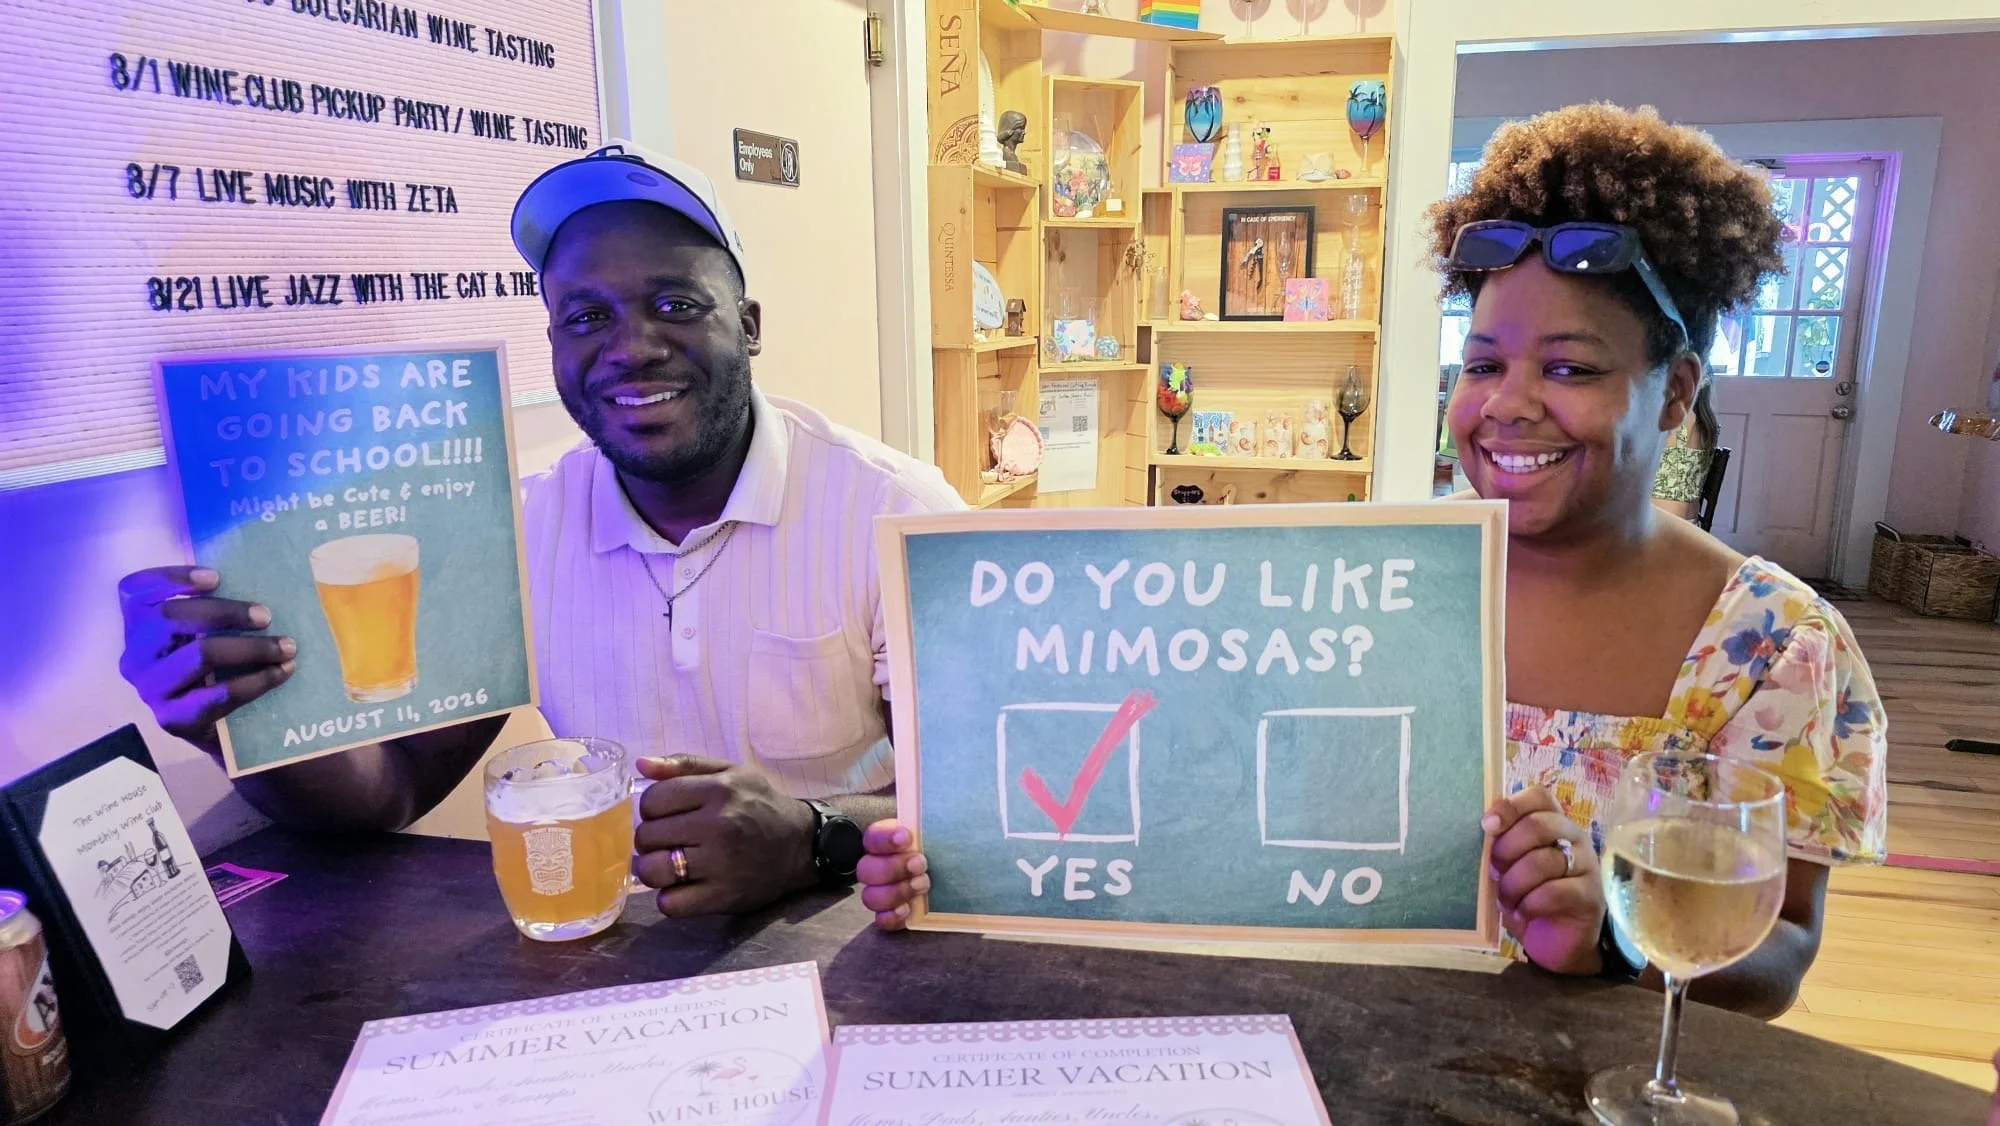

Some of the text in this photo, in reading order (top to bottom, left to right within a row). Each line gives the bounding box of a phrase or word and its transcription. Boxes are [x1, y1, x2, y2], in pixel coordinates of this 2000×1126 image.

[427, 12, 478, 53] WINE
[485, 27, 555, 68] TASTING
[110, 52, 161, 94] 8/1
[168, 58, 242, 105] WINE
[245, 74, 304, 113] CLUB
[311, 83, 386, 123] PICKUP
[470, 108, 517, 142] WINE
[522, 117, 588, 150] TASTING
[738, 140, 773, 159] Employees
[739, 157, 755, 175] Only
[126, 162, 458, 213] 8/7 LIVE MUSIC WITH ZETA
[212, 275, 274, 309] LIVE
[284, 273, 344, 306] JAZZ
[351, 272, 404, 305] WITH
[411, 271, 451, 300] THE
[457, 271, 488, 299] CAT
[495, 271, 508, 297] &
[510, 270, 540, 297] THE
[200, 359, 473, 400] MY KIDS ARE
[216, 400, 469, 441] GOING BACK
[209, 437, 483, 487] TO SCHOOL!!!!
[230, 491, 301, 522] Might
[307, 491, 335, 509] be
[421, 477, 475, 500] enjoy
[315, 505, 406, 531] a BEER!
[970, 557, 1415, 612] DO YOU LIKE
[1016, 625, 1375, 677] MIMOSAS?
[283, 708, 385, 747] AUGUST
[428, 688, 489, 715] 2026
[1016, 854, 1133, 901] YES
[1286, 866, 1382, 905] NO
[382, 1034, 568, 1075] SUMMER
[585, 1002, 790, 1044] VACATION
[459, 998, 727, 1042] CERTIFICATE OF COMPLETION
[863, 1060, 1274, 1091] SUMMER VACATION
[933, 1046, 1201, 1063] CERTIFICATE OF COMPLETION
[647, 1086, 818, 1125] WINE HOUSE
